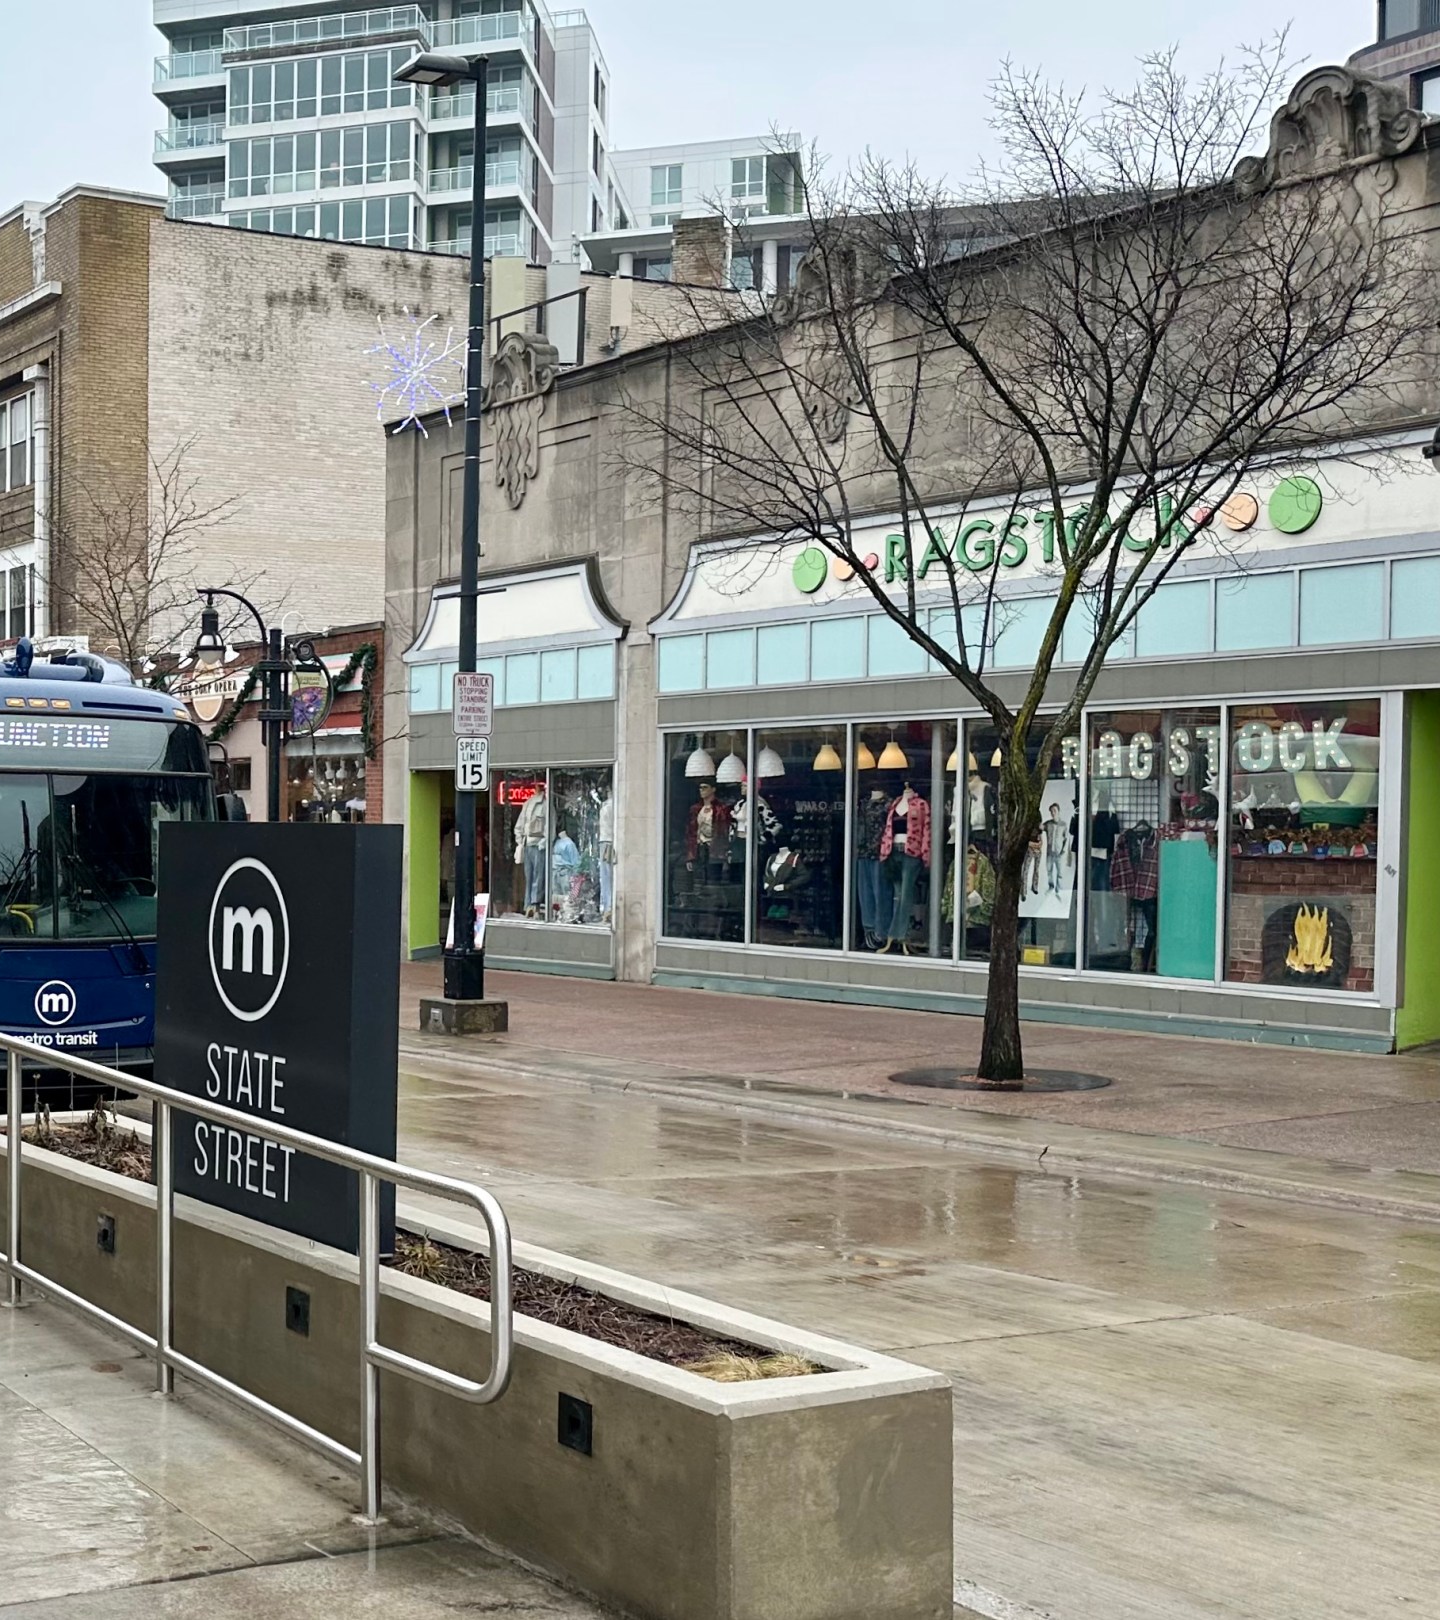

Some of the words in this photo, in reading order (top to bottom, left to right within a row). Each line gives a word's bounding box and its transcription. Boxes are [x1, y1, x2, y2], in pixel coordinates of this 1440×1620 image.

[214, 680, 237, 693] OPERA
[457, 676, 467, 687] NO
[469, 676, 490, 688] TRUCK
[459, 687, 488, 696] STOPPING
[459, 695, 488, 704] STANDING
[461, 705, 486, 714] PARKING
[459, 741, 486, 752] SPEED
[461, 751, 483, 762] LIMIT
[461, 764, 483, 786] 15
[55, 1030, 98, 1046] transit
[206, 1041, 287, 1115] STATE
[193, 1120, 297, 1203] STREET
